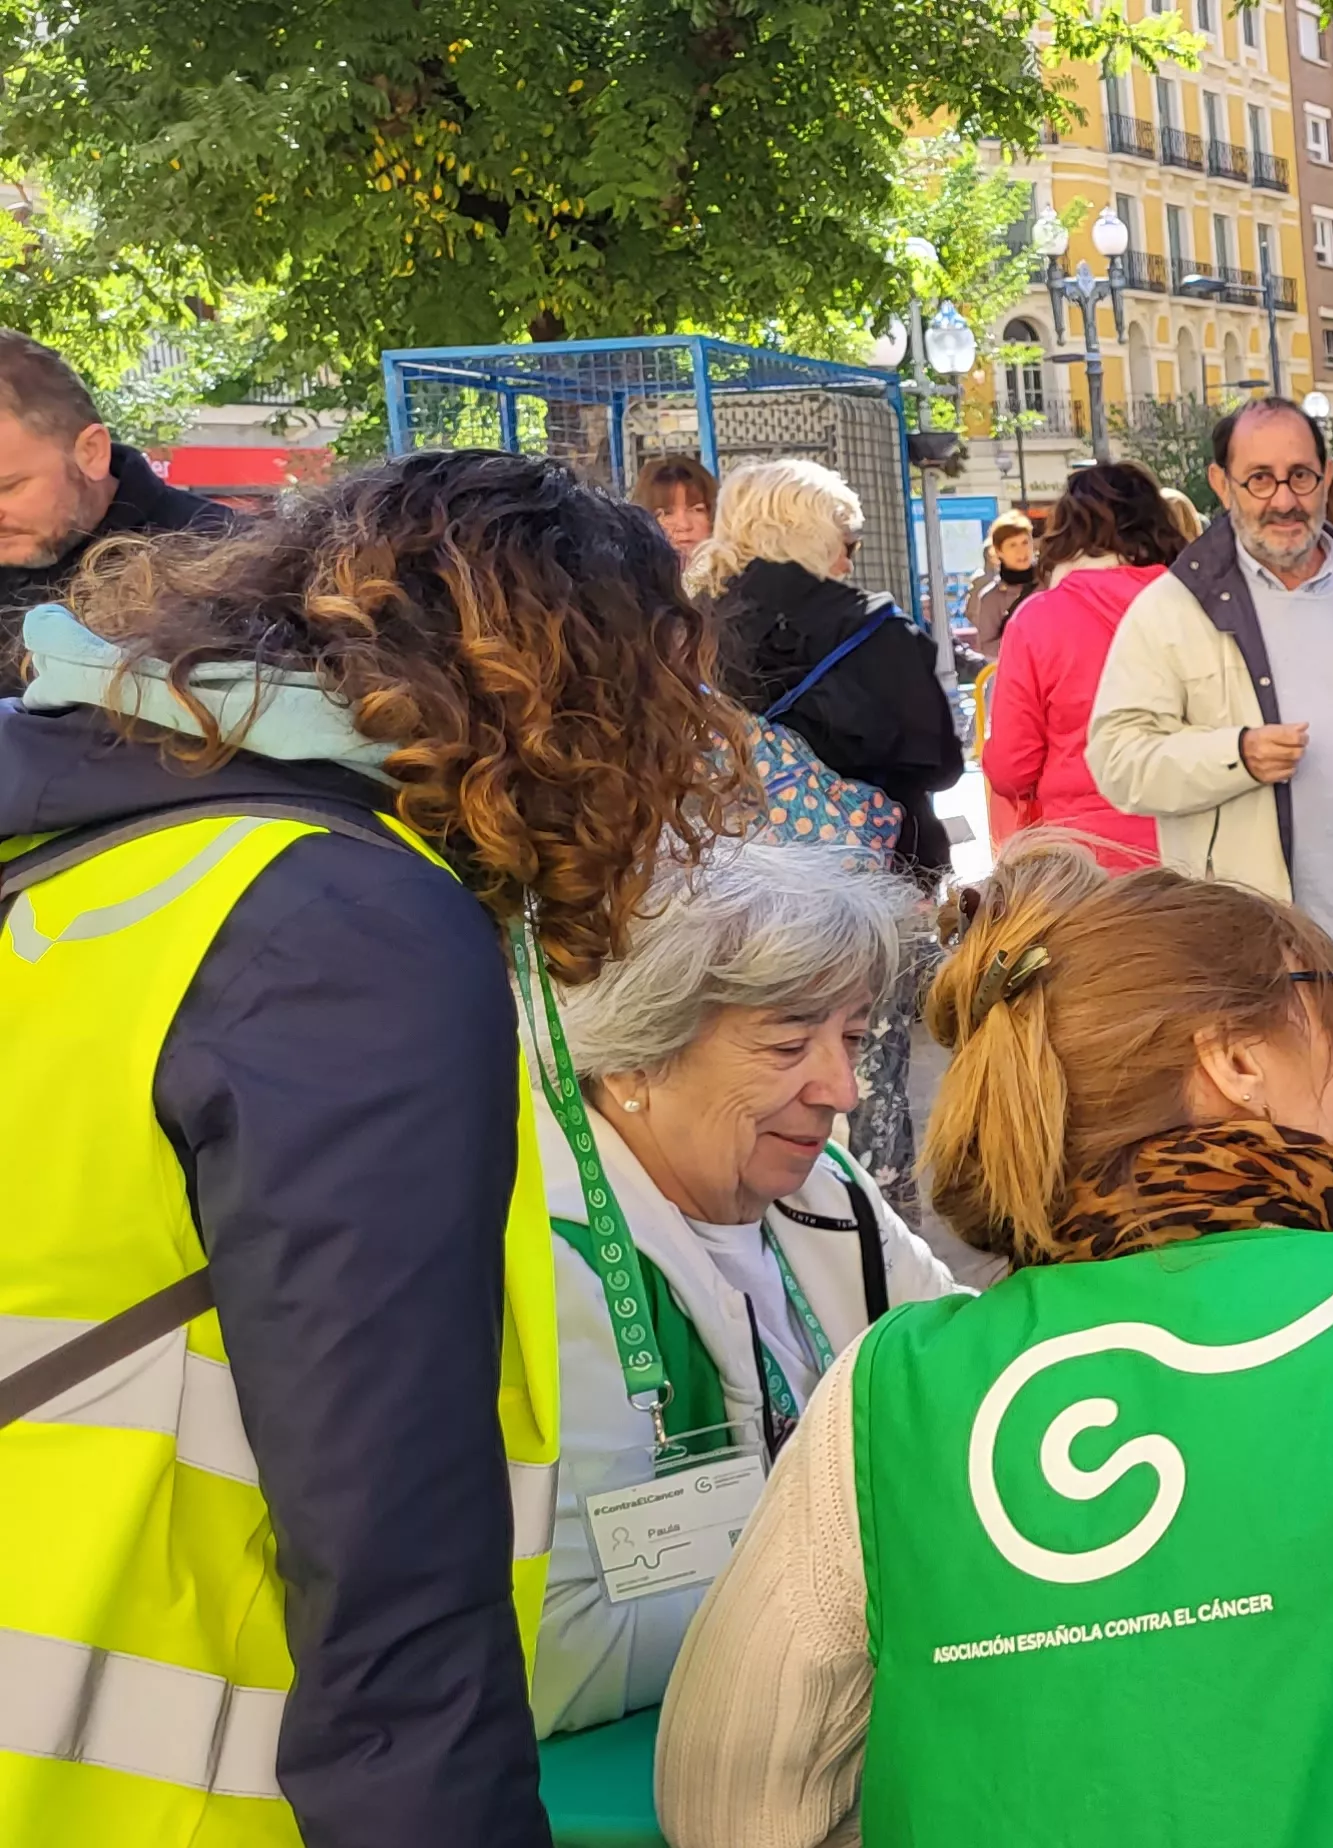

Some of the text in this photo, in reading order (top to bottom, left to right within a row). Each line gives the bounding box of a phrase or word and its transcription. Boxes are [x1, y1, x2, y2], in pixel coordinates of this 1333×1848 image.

[933, 1594, 1274, 1664] ASOCIACIÓN ESPAÑOLA CONTRA EL CÁNCER
